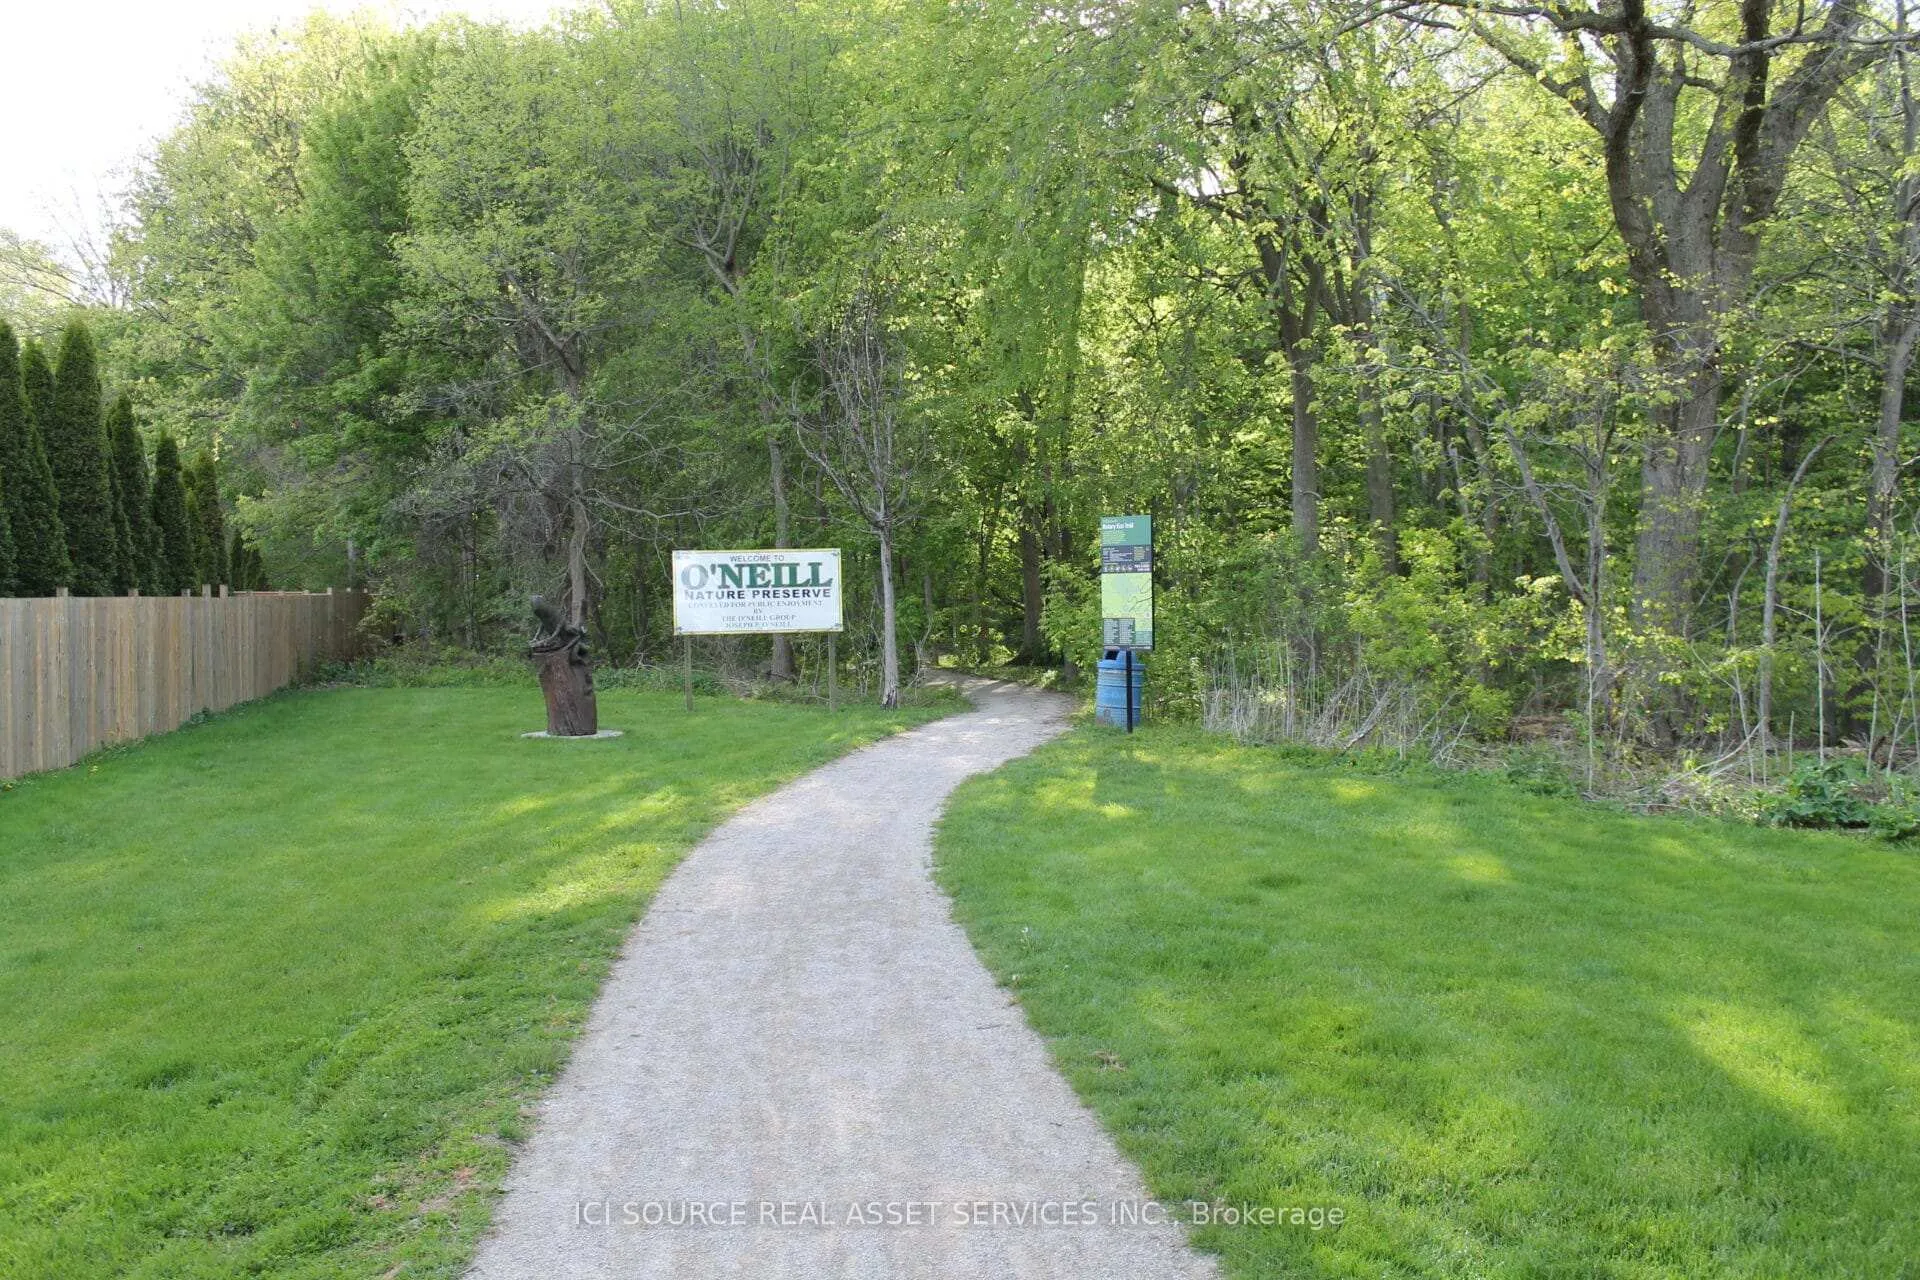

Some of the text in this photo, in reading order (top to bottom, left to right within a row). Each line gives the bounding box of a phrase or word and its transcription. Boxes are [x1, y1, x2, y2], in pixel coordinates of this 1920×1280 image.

[681, 562, 833, 590] O'NEILL
[684, 588, 831, 601] NATURE PRESERVE
[729, 600, 747, 608] FOR
[748, 600, 776, 608] PUBLIC
[777, 600, 823, 608] ENJOYMENT
